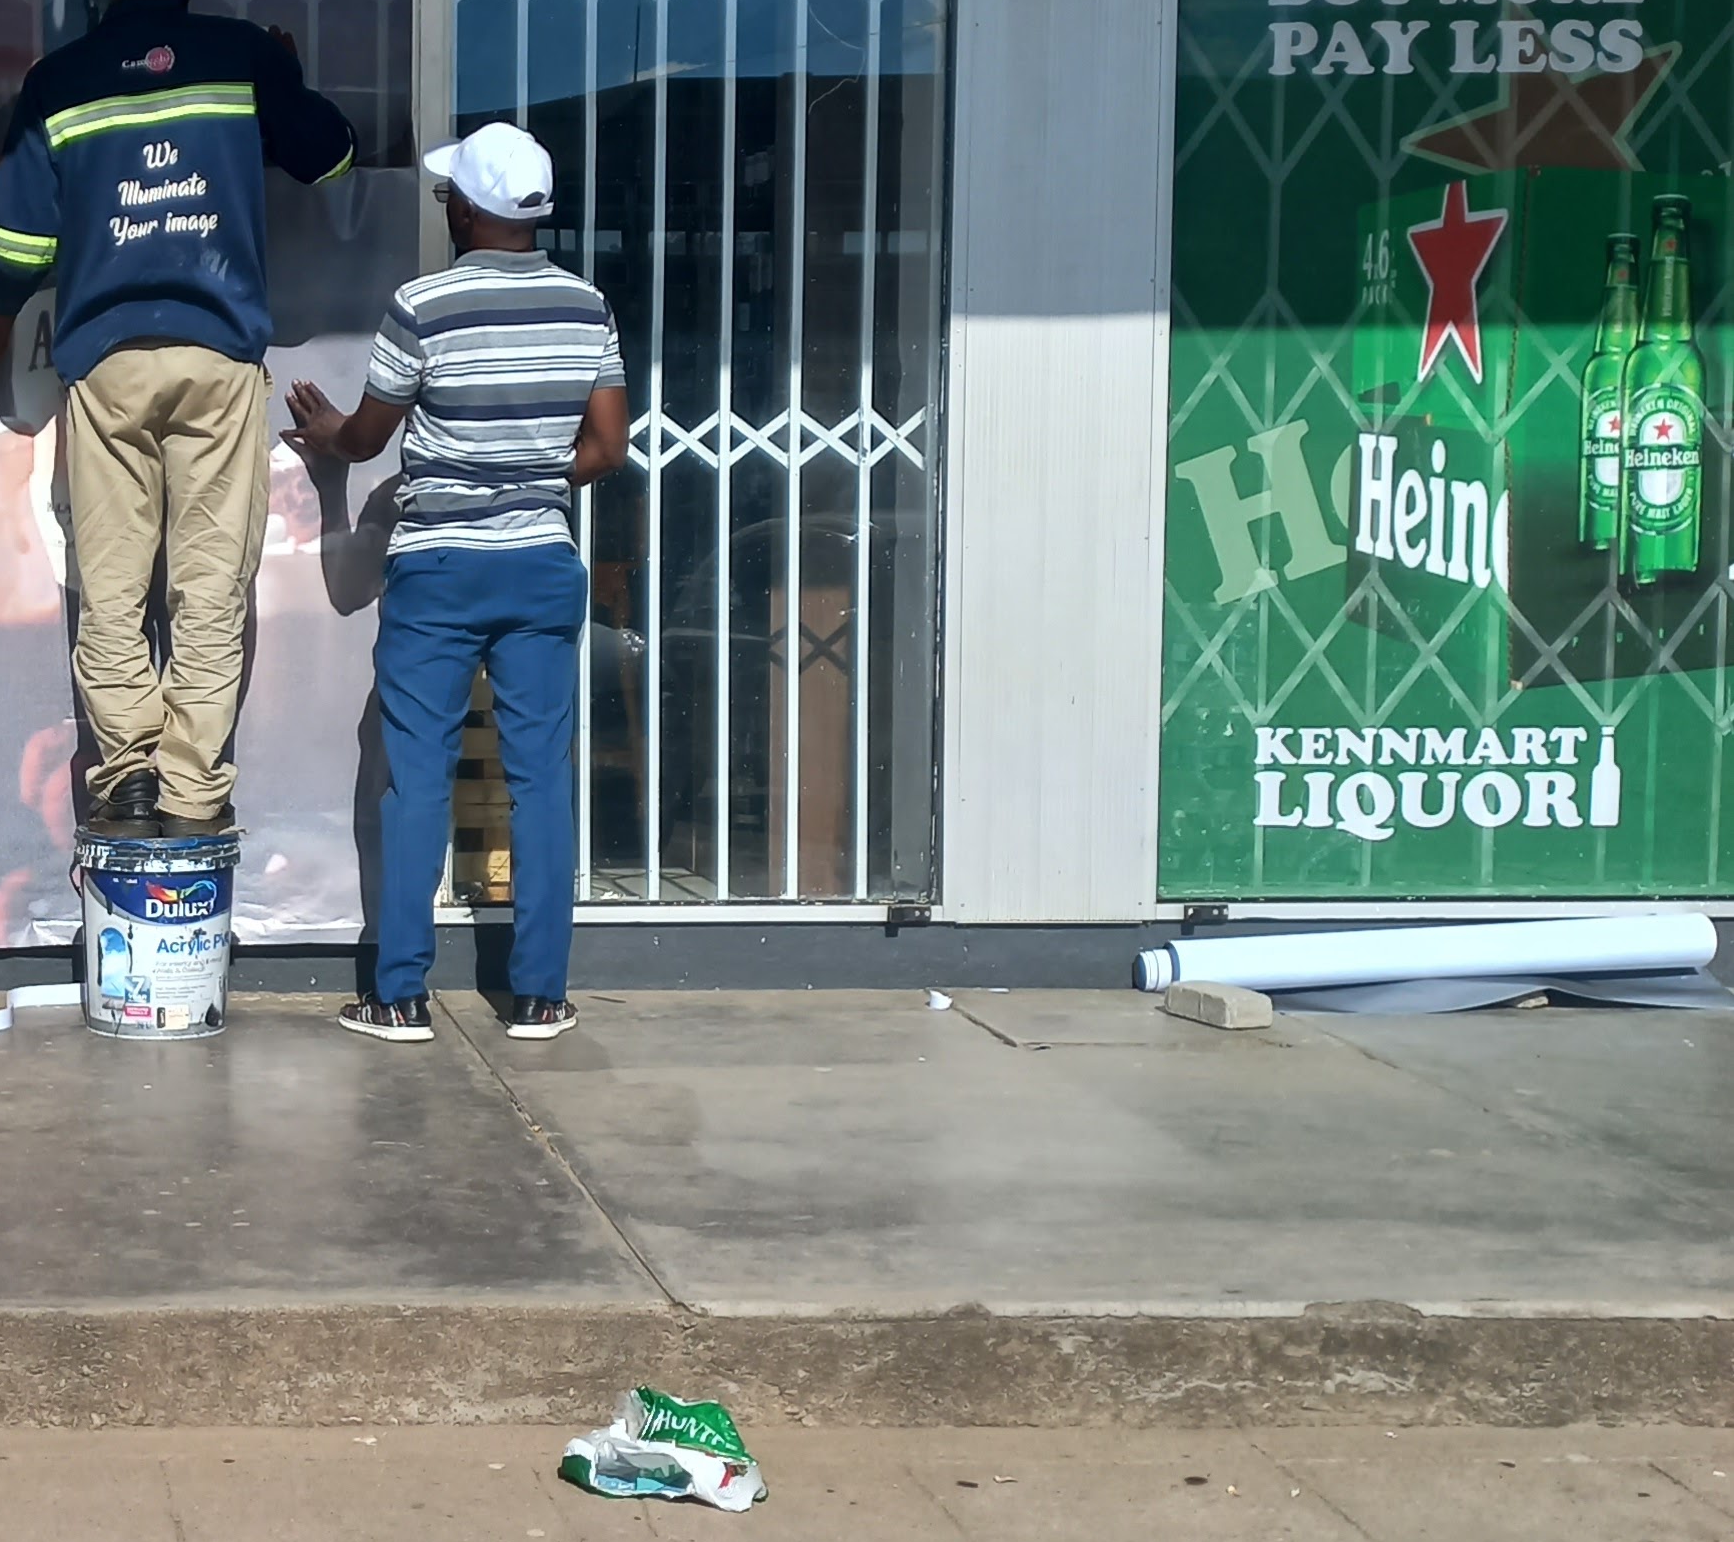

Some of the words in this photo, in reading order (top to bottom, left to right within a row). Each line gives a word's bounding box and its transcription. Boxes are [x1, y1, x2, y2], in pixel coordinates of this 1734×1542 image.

[1268, 20, 1431, 75] PAY
[1448, 18, 1644, 74] LESS
[143, 141, 179, 169] We
[118, 172, 207, 206] Illuminate
[109, 215, 159, 246] Your
[165, 211, 218, 238] image
[1624, 447, 1700, 468] Heineken
[1254, 727, 1588, 766] KENNMART
[1253, 770, 1584, 841] LIQUOR
[145, 899, 210, 918] Dulux
[156, 937, 211, 956] Acrylic
